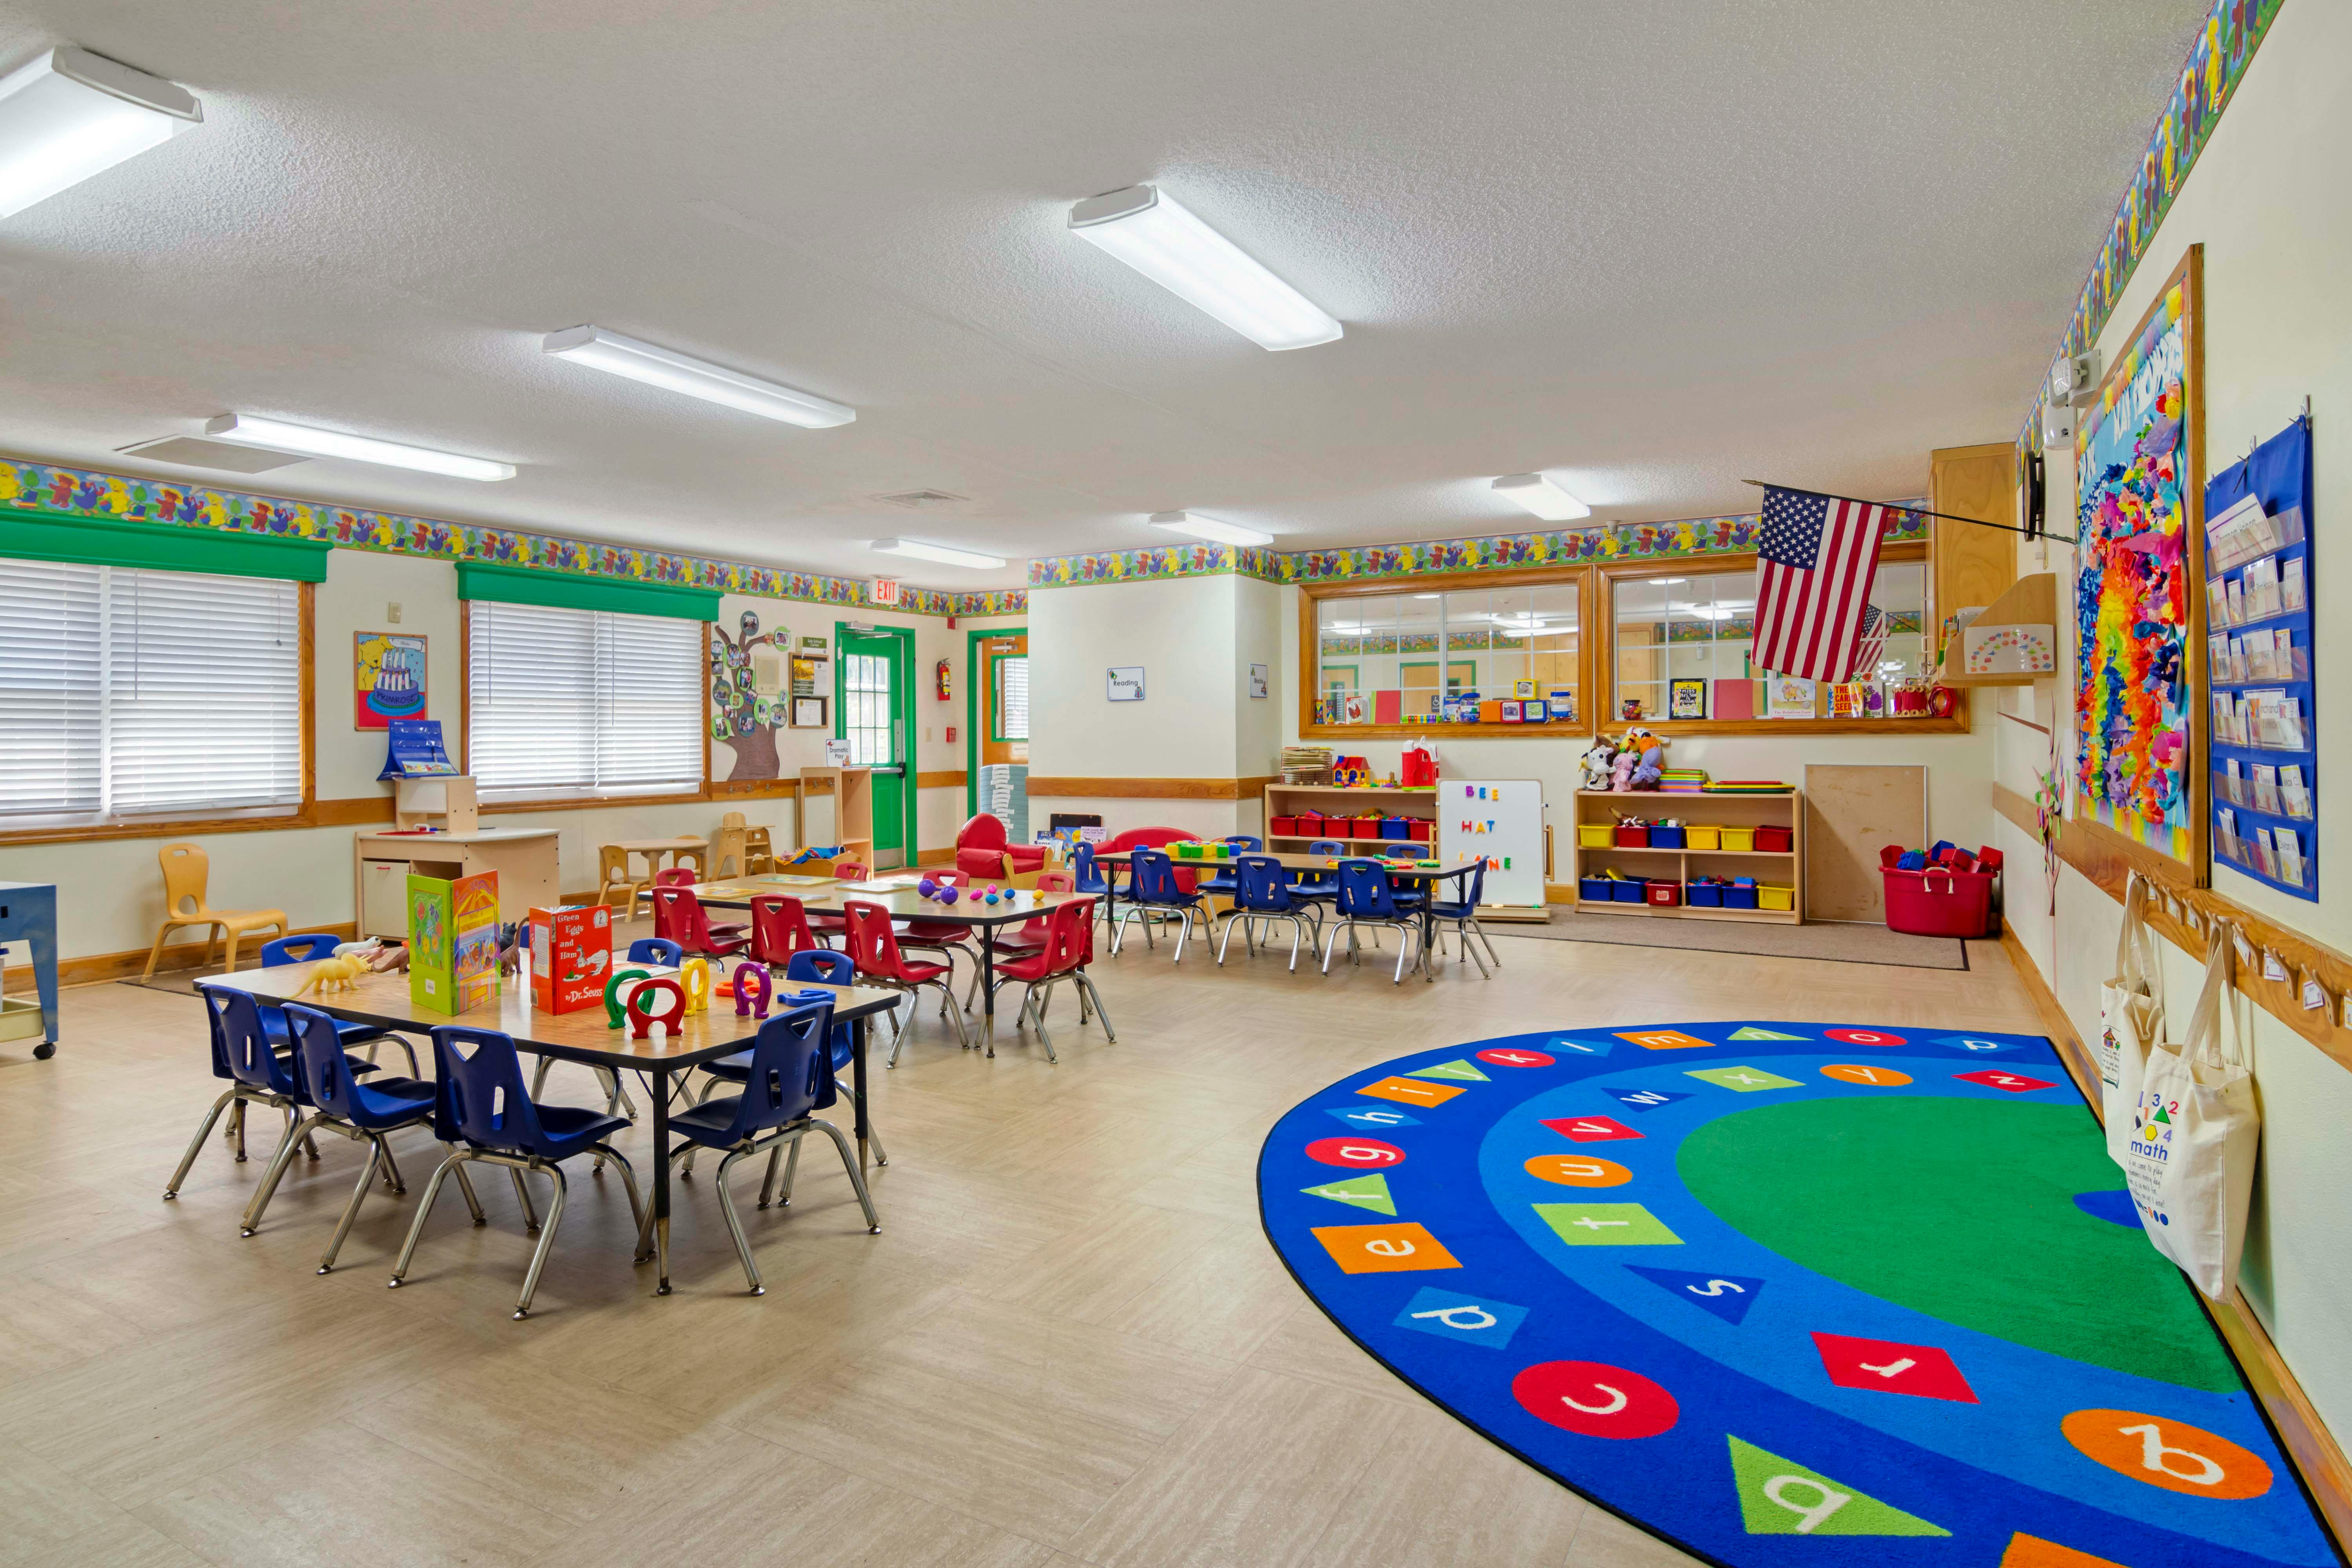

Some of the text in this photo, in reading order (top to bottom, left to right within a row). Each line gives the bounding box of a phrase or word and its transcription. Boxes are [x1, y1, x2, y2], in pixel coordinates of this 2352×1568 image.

[878, 580, 896, 602] EXIT
[377, 691, 417, 704] PRIMROSE
[1466, 786, 1499, 800] BEE
[1462, 820, 1495, 833] HAT
[565, 925, 584, 936] Eggs
[570, 991, 582, 1002] Dr.
[583, 986, 603, 998] Seuss
[1637, 1031, 1688, 1044] m
[1848, 1033, 1881, 1042] o
[1967, 1039, 1998, 1051] p
[1488, 1053, 1539, 1063] k
[1436, 1066, 1483, 1081] j
[1723, 1073, 1767, 1085] x
[1840, 1069, 1880, 1083] y
[1989, 1076, 2026, 1086] z
[1389, 1085, 1434, 1096] i
[1619, 1090, 1670, 1105] w
[2152, 1094, 2160, 1107] 3
[2144, 1107, 2149, 1120] 1
[2168, 1101, 2179, 1114] 2
[1347, 1112, 1403, 1124] h
[1571, 1122, 1613, 1133] v
[2163, 1129, 2172, 1142] 4
[1340, 1147, 1396, 1161] g
[2131, 1141, 2168, 1161] math
[1560, 1163, 1604, 1177] u
[2153, 1165, 2163, 1178] play
[1319, 1188, 1383, 1200] f
[1573, 1216, 1630, 1231] t
[1366, 1240, 1415, 1256] e
[1688, 1279, 1744, 1296] s
[1411, 1306, 1497, 1330] d
[1860, 1358, 1916, 1377] r
[1562, 1384, 1627, 1414] c
[2119, 1424, 2224, 1485] q
[1763, 1475, 1851, 1535] b
